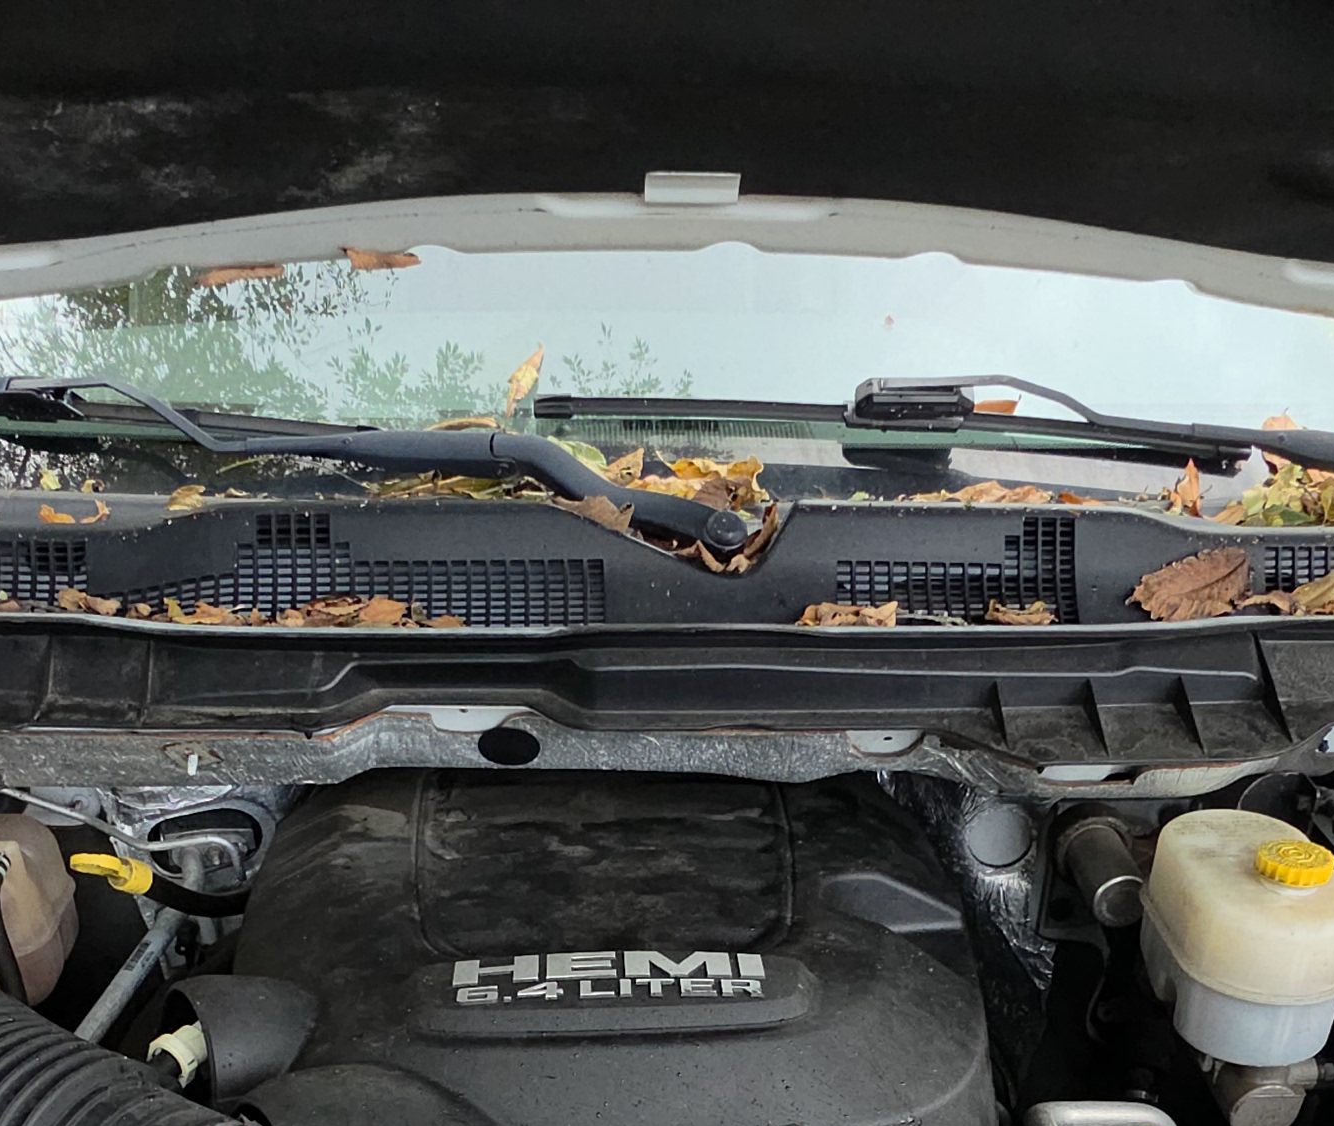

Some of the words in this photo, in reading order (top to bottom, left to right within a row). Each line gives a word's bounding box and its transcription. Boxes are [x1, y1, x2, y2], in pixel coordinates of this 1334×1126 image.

[452, 950, 766, 986] HEMI
[456, 980, 564, 1005] 6.4
[579, 978, 765, 999] LITER
